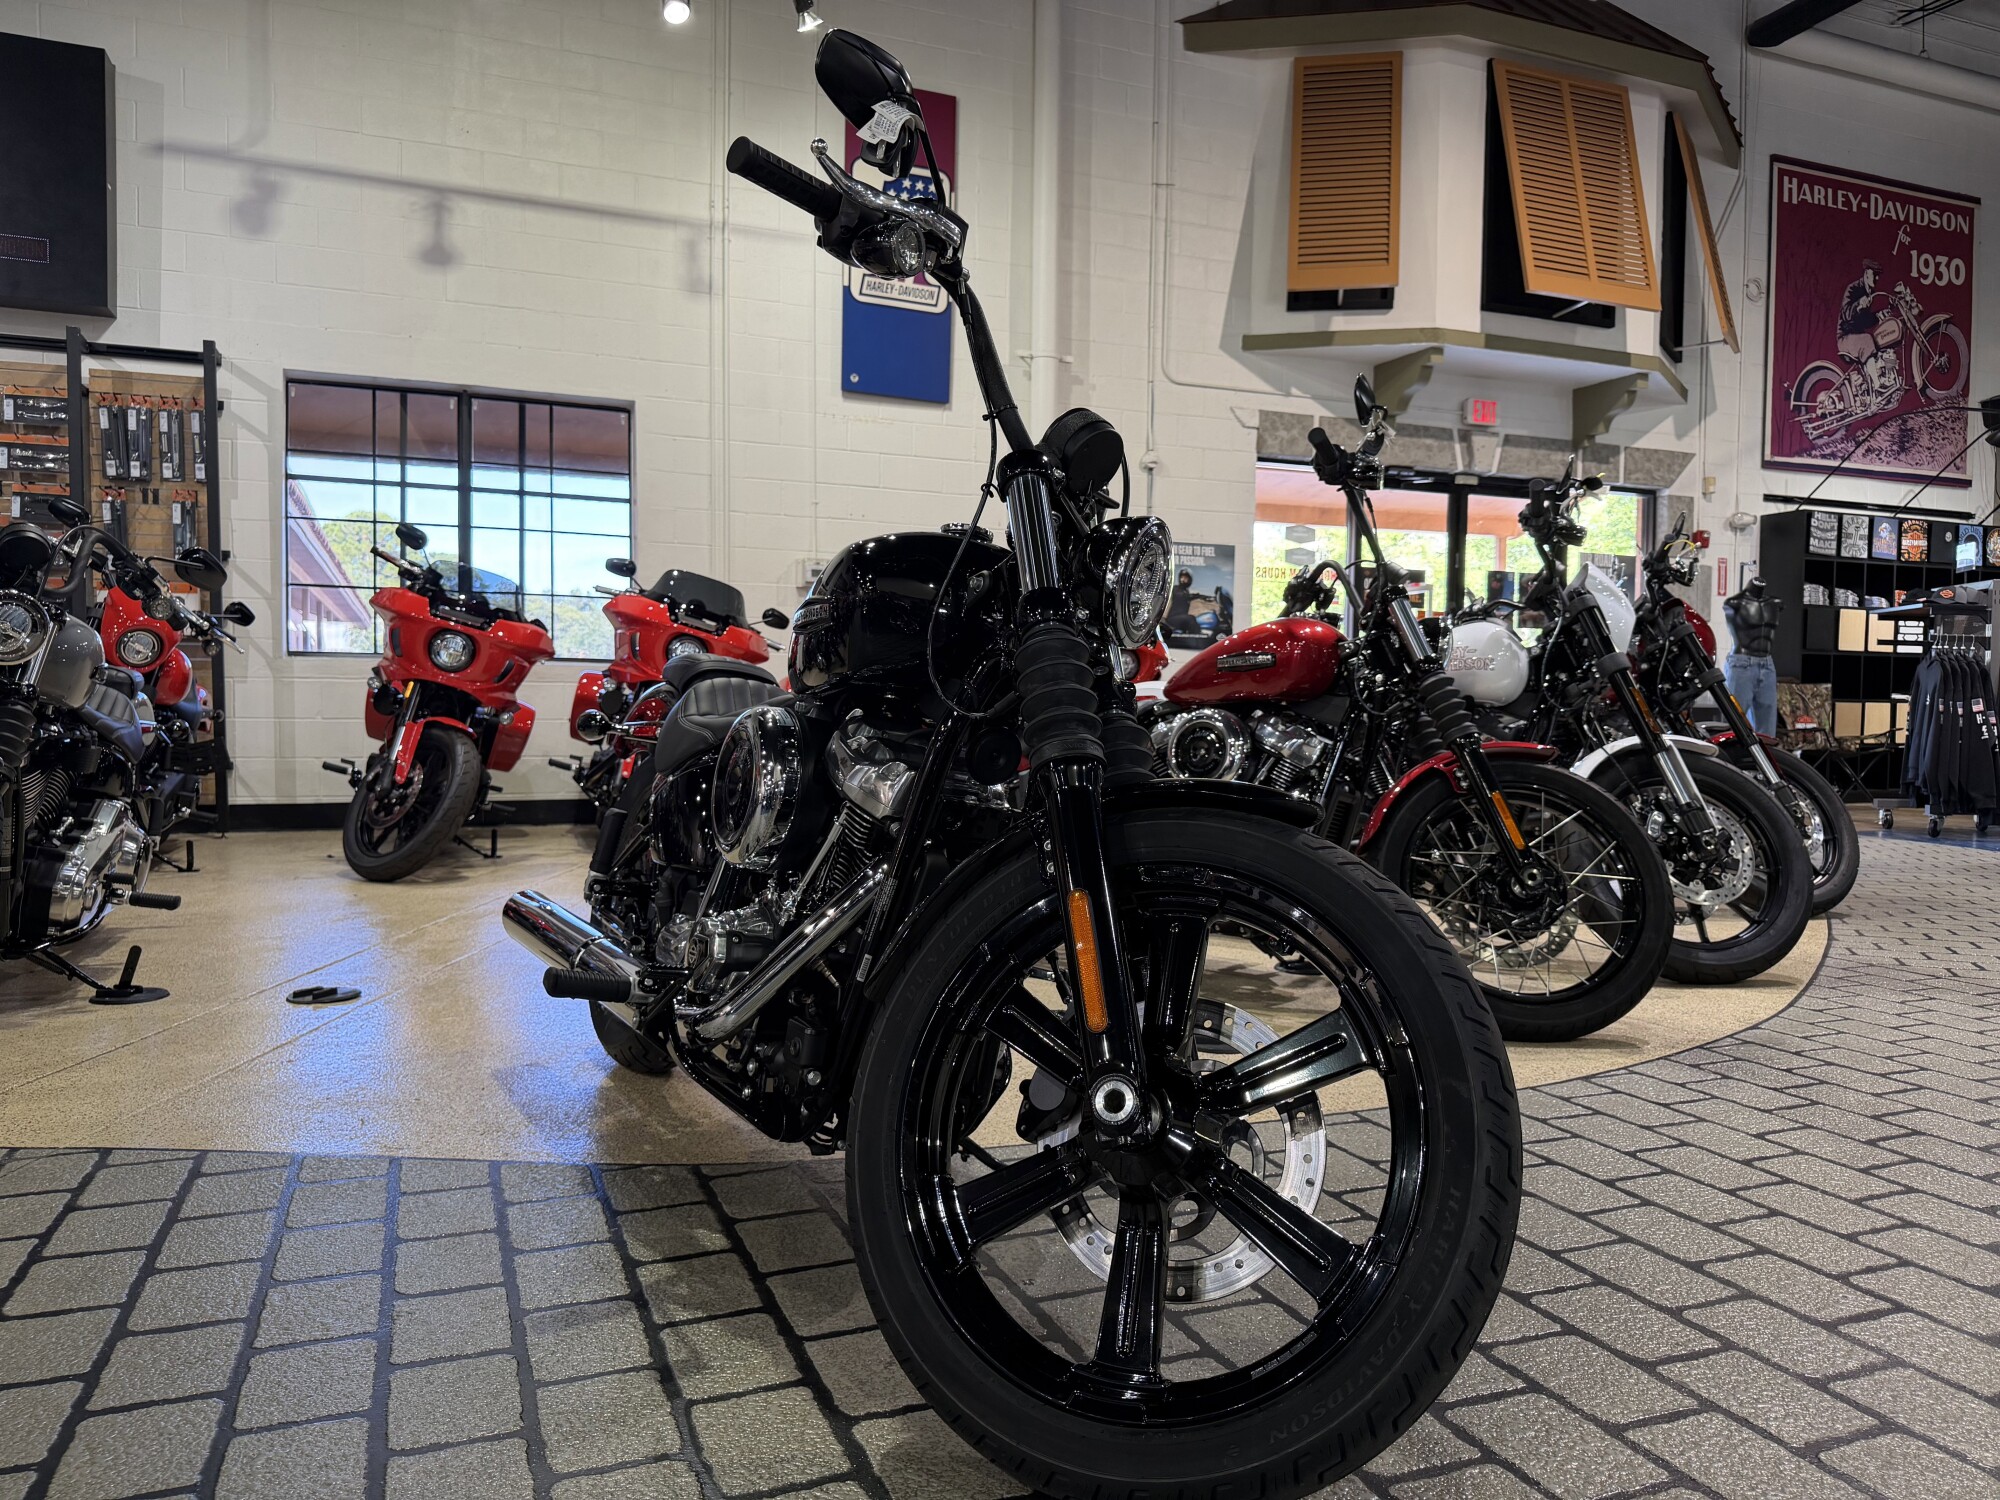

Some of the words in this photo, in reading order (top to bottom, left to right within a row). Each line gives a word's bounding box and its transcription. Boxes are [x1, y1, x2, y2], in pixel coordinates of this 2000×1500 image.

[1783, 176, 1969, 234] HARLEY-DAVIDSON
[1891, 224, 1911, 255] for
[1910, 250, 1966, 287] 1930
[1473, 399, 1497, 425] EXIT
[1814, 511, 1837, 522] HELL
[1809, 537, 1837, 549] MAKE
